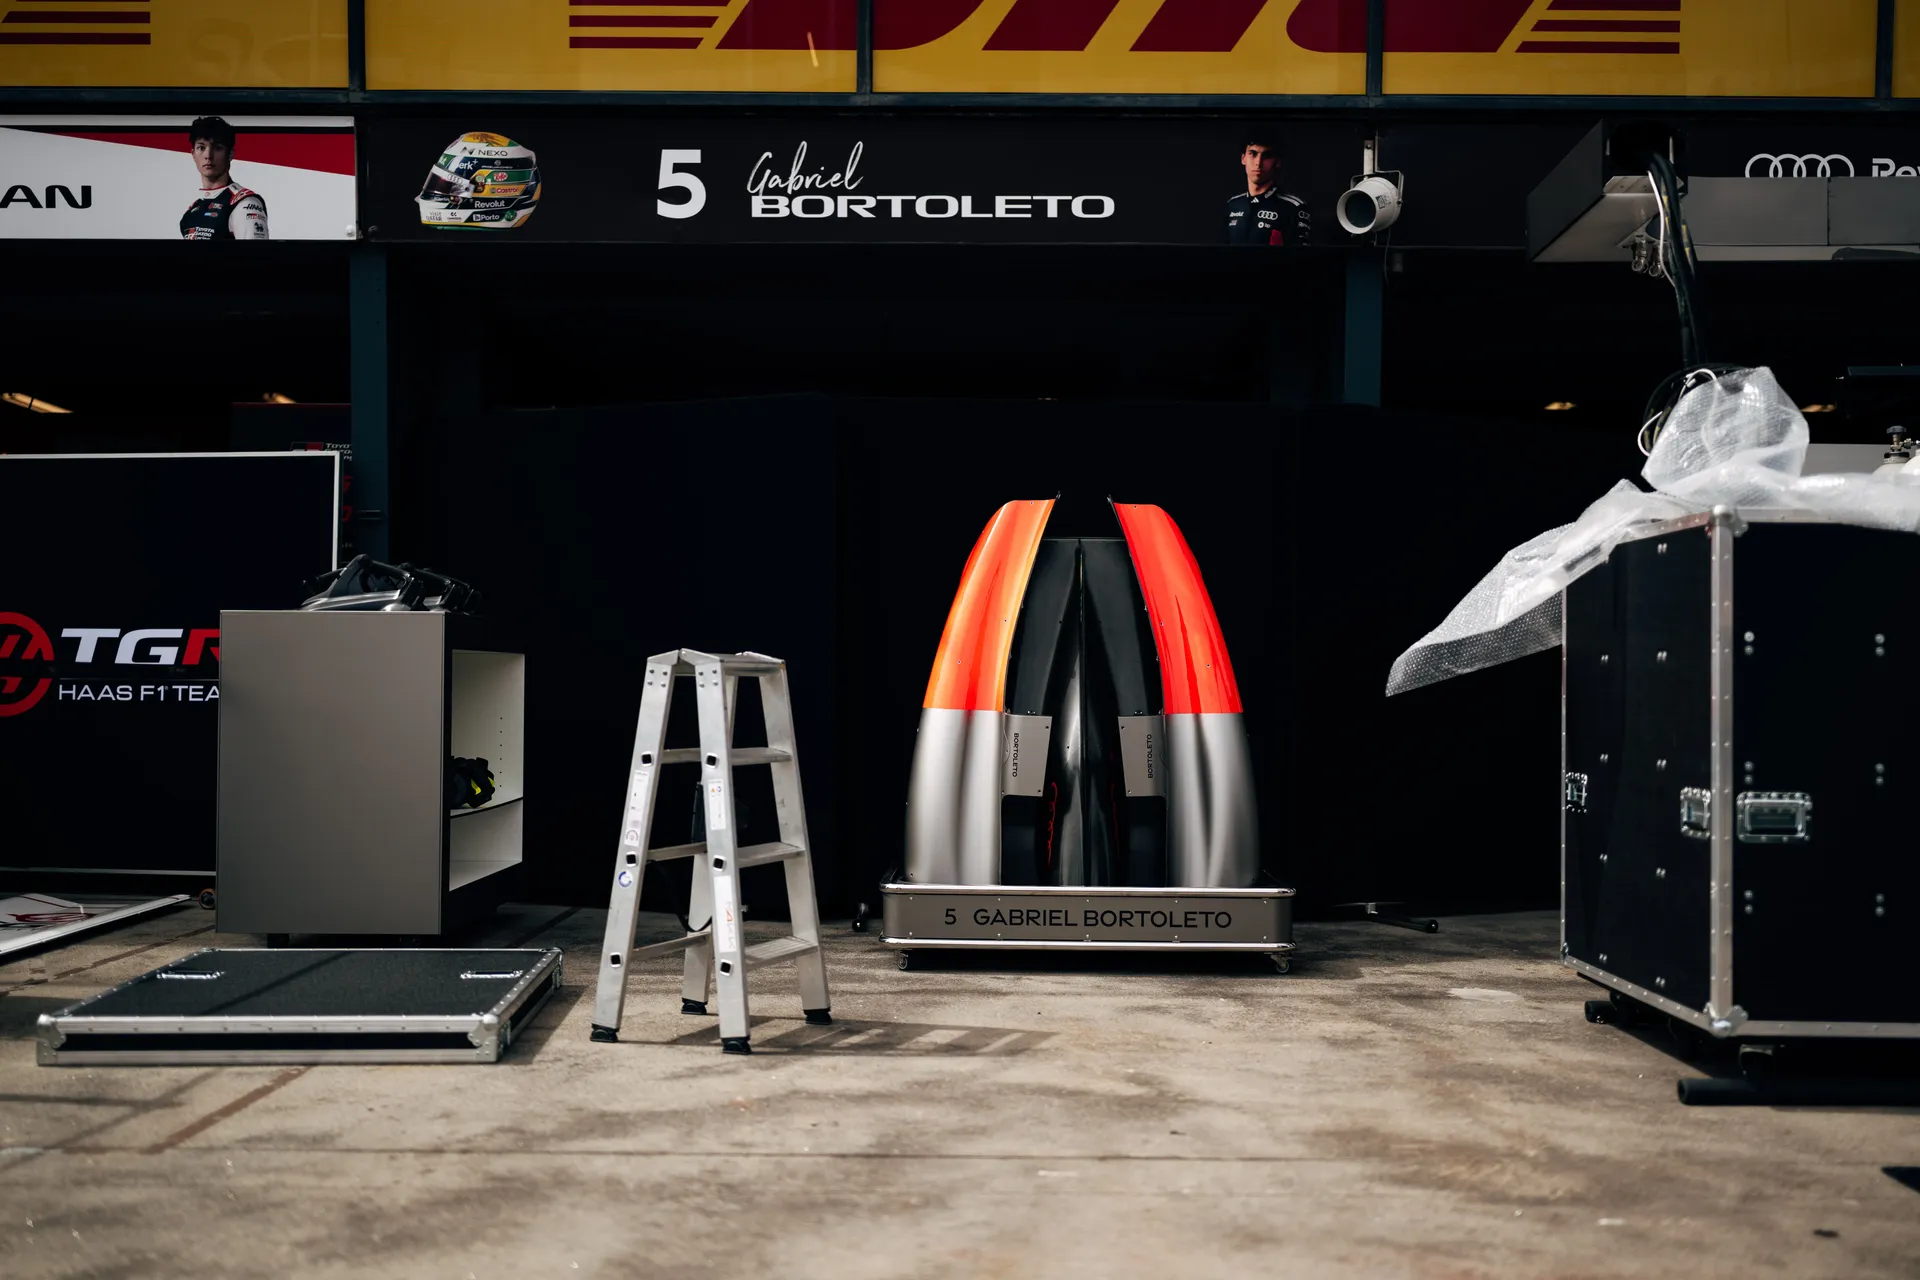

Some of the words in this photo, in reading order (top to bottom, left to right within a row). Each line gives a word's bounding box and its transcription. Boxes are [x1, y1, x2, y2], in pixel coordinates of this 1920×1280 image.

[746, 140, 864, 195] Gabriel
[1872, 158, 1920, 177] Re
[656, 148, 707, 219] 5
[474, 199, 505, 208] Revolut
[751, 194, 1115, 219] BORTOLETO
[59, 685, 133, 701] HAAS
[1146, 734, 1154, 779] BORTOLETO
[944, 908, 957, 925] 5
[973, 908, 1078, 927] GABRIEL
[1083, 910, 1232, 929] BORTOLETO
